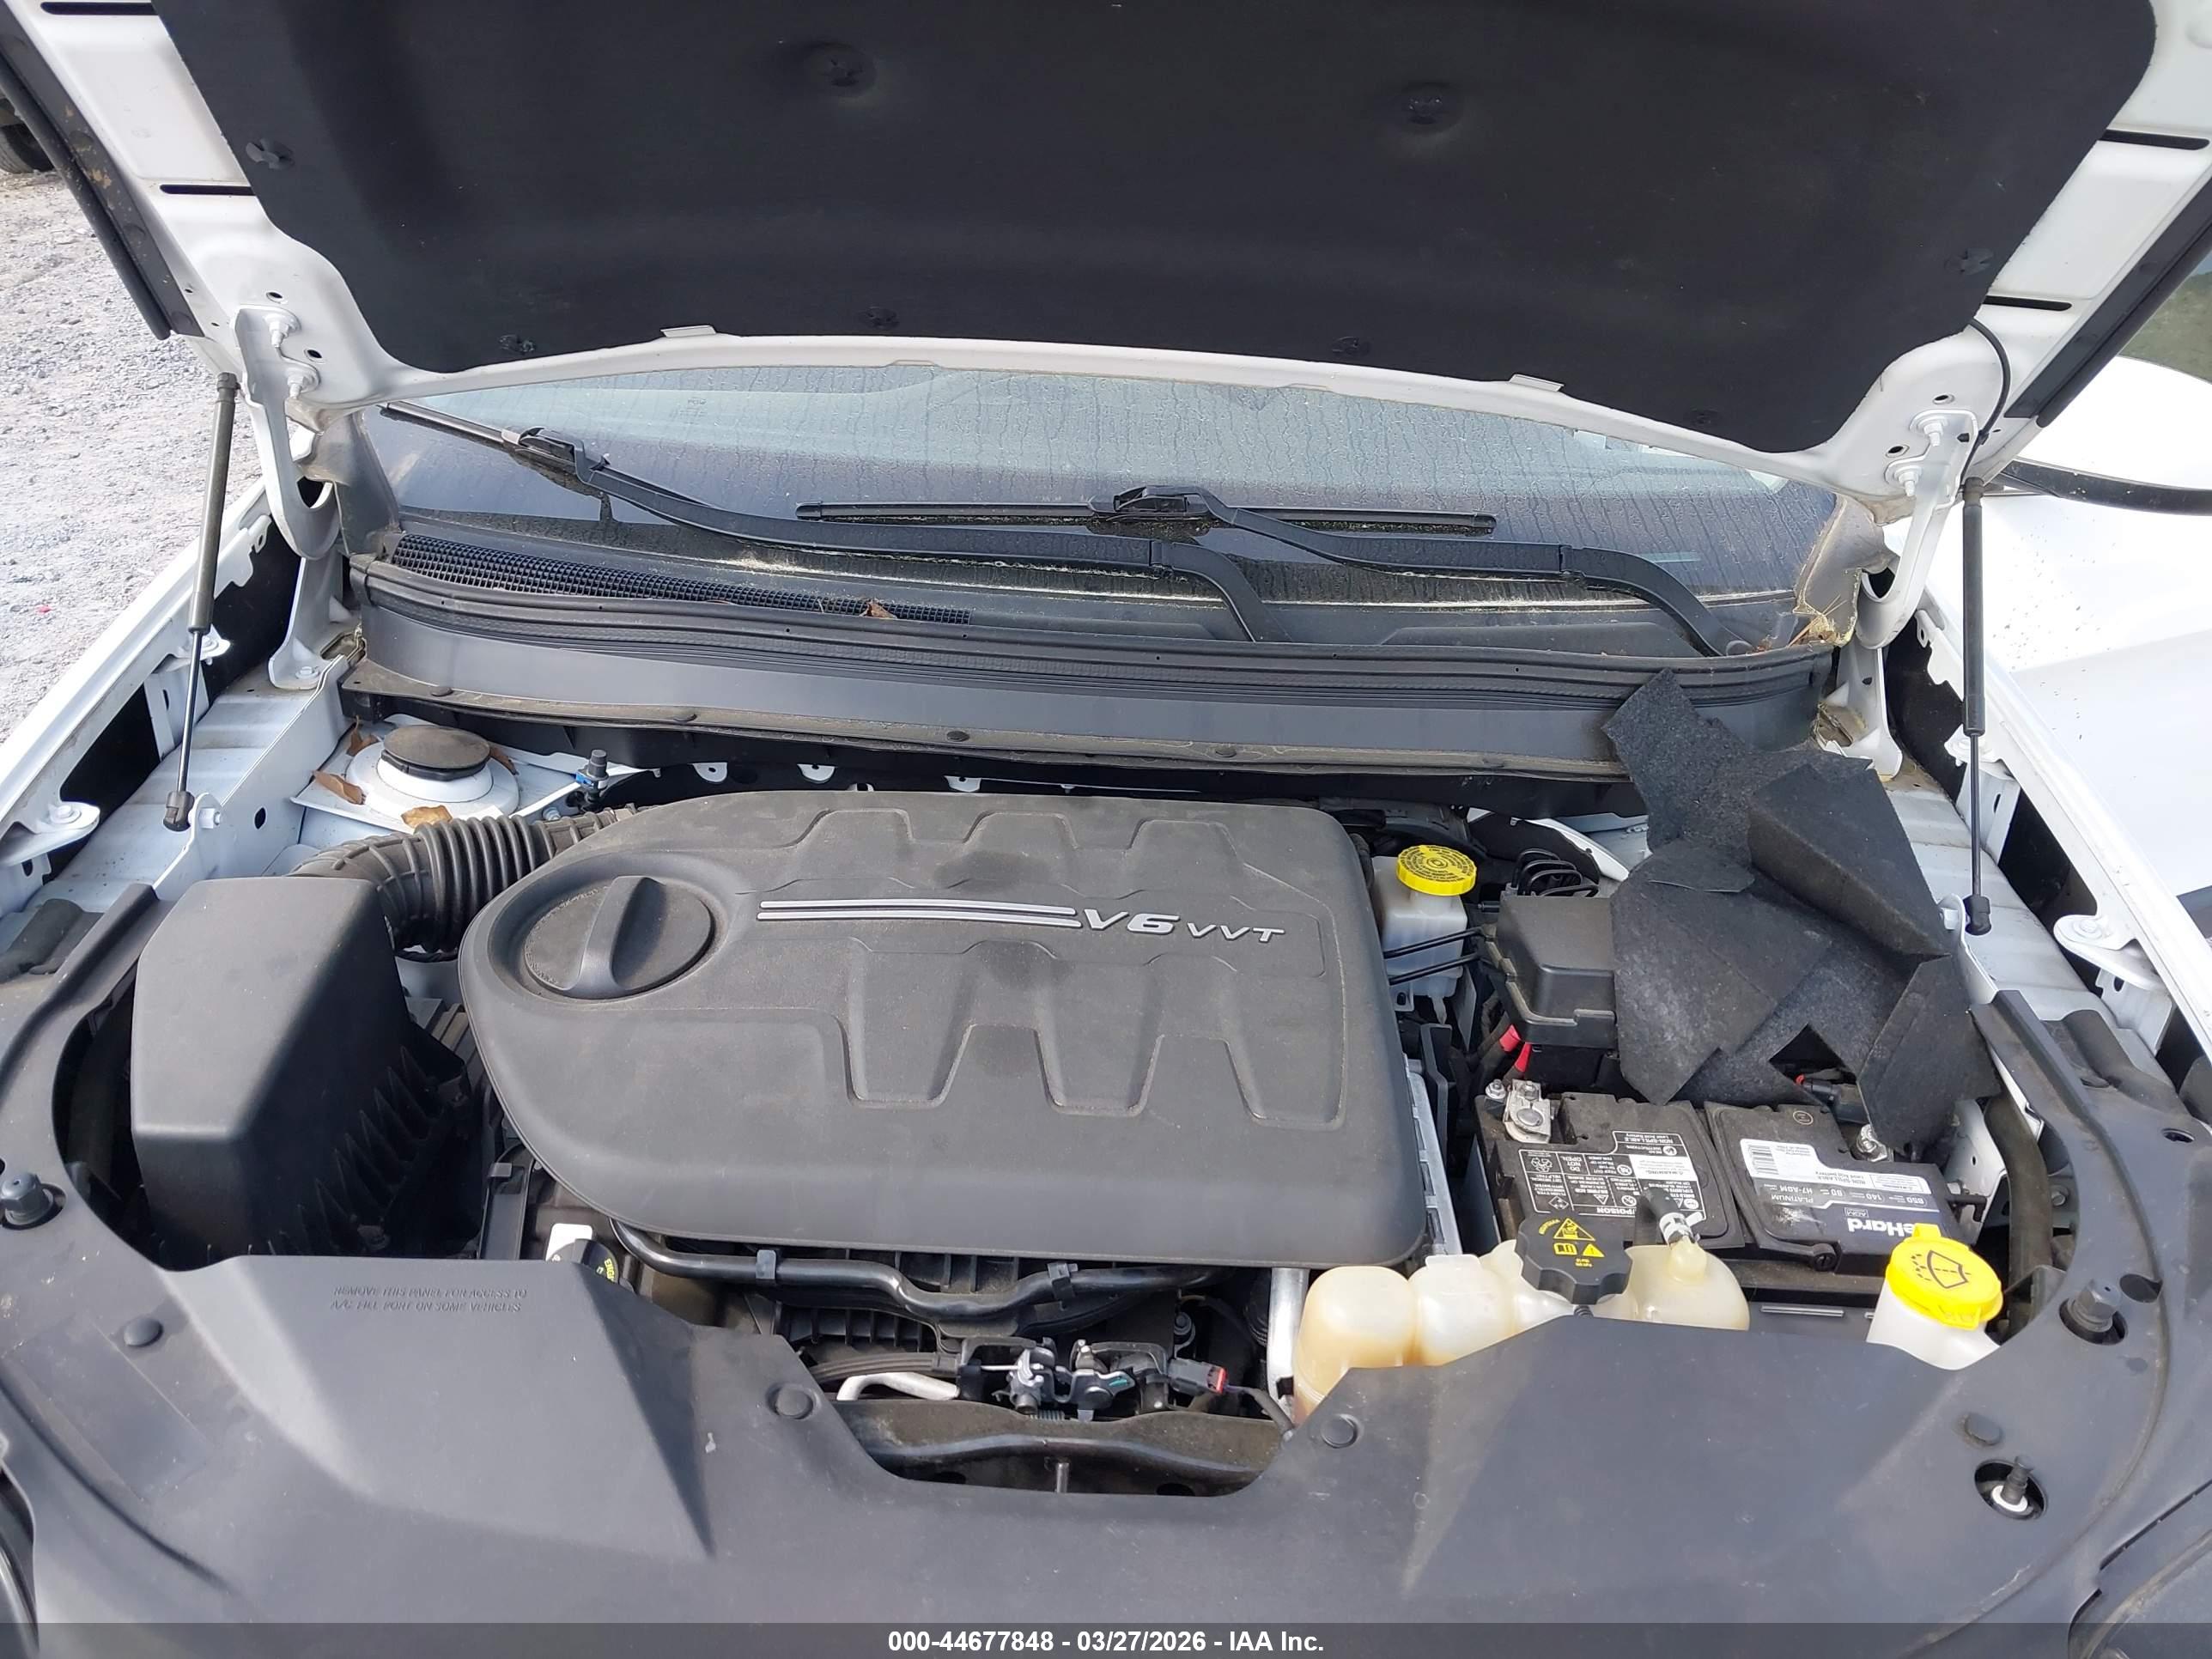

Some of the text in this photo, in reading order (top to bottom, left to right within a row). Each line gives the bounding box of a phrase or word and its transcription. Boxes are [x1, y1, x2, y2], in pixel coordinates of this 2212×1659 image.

[1084, 908, 1285, 943] V6 VVT
[1771, 1194, 1814, 1203] PLATINUM
[333, 1286, 527, 1298] REMOVE THIS PANEL FOR ACCESS TO
[416, 1302, 433, 1311] ON
[435, 1302, 466, 1311] SOME
[470, 1303, 522, 1313] VEHICLES
